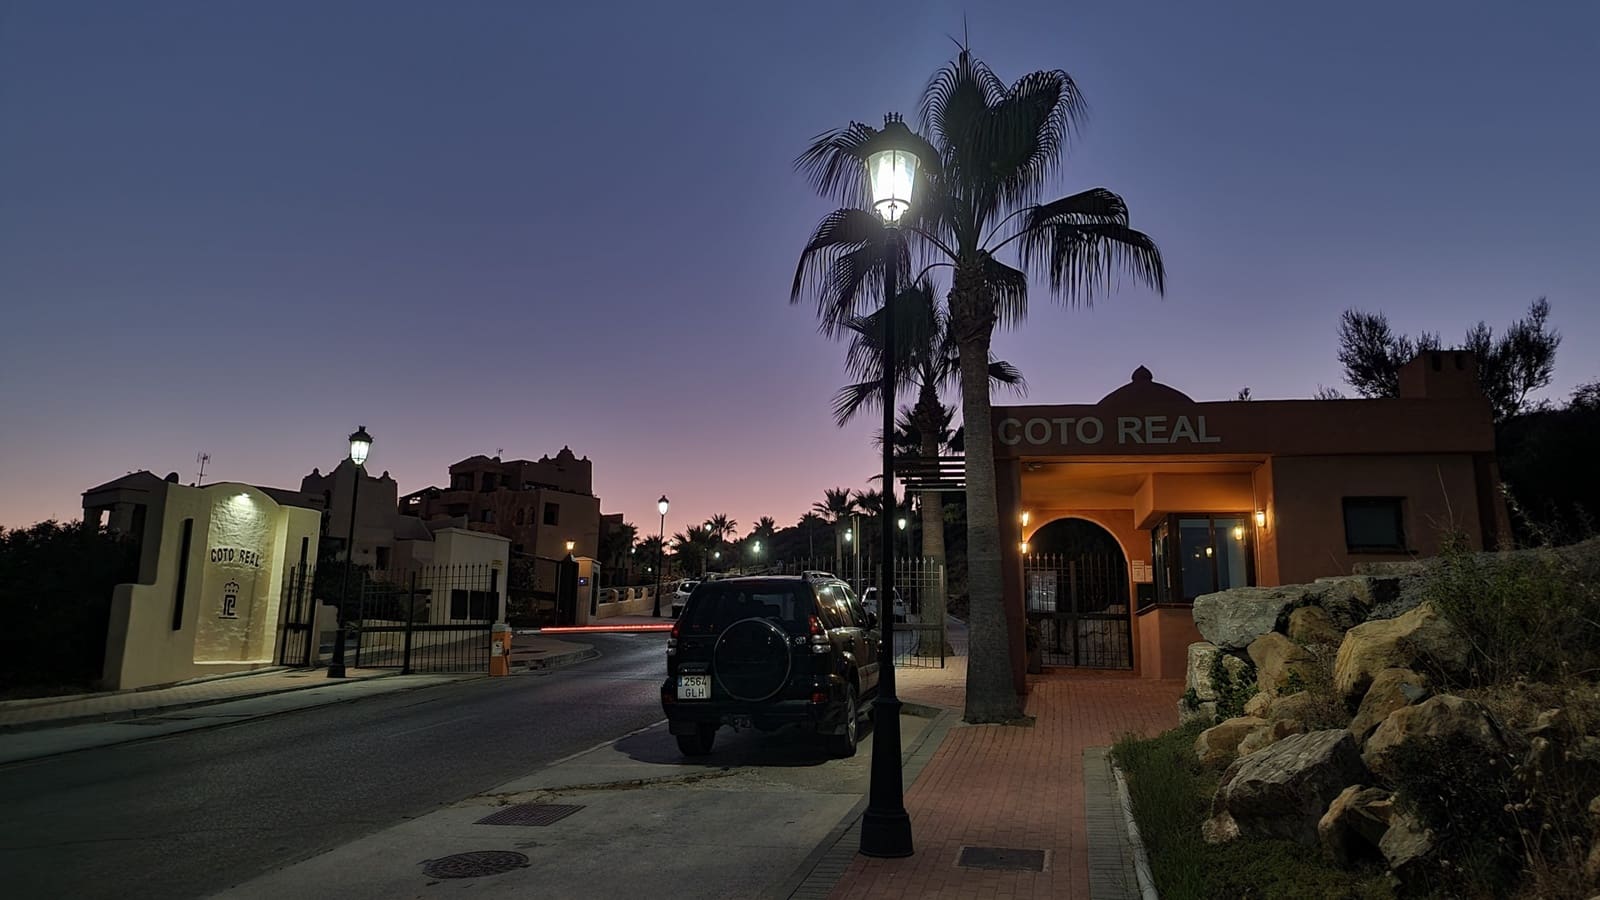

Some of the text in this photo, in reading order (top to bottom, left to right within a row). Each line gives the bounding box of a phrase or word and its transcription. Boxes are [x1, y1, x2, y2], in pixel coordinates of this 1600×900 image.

[998, 415, 1222, 446] COTO REAL
[210, 548, 260, 568] COTO REAL
[684, 676, 708, 687] 2564
[685, 688, 705, 698] GLH
